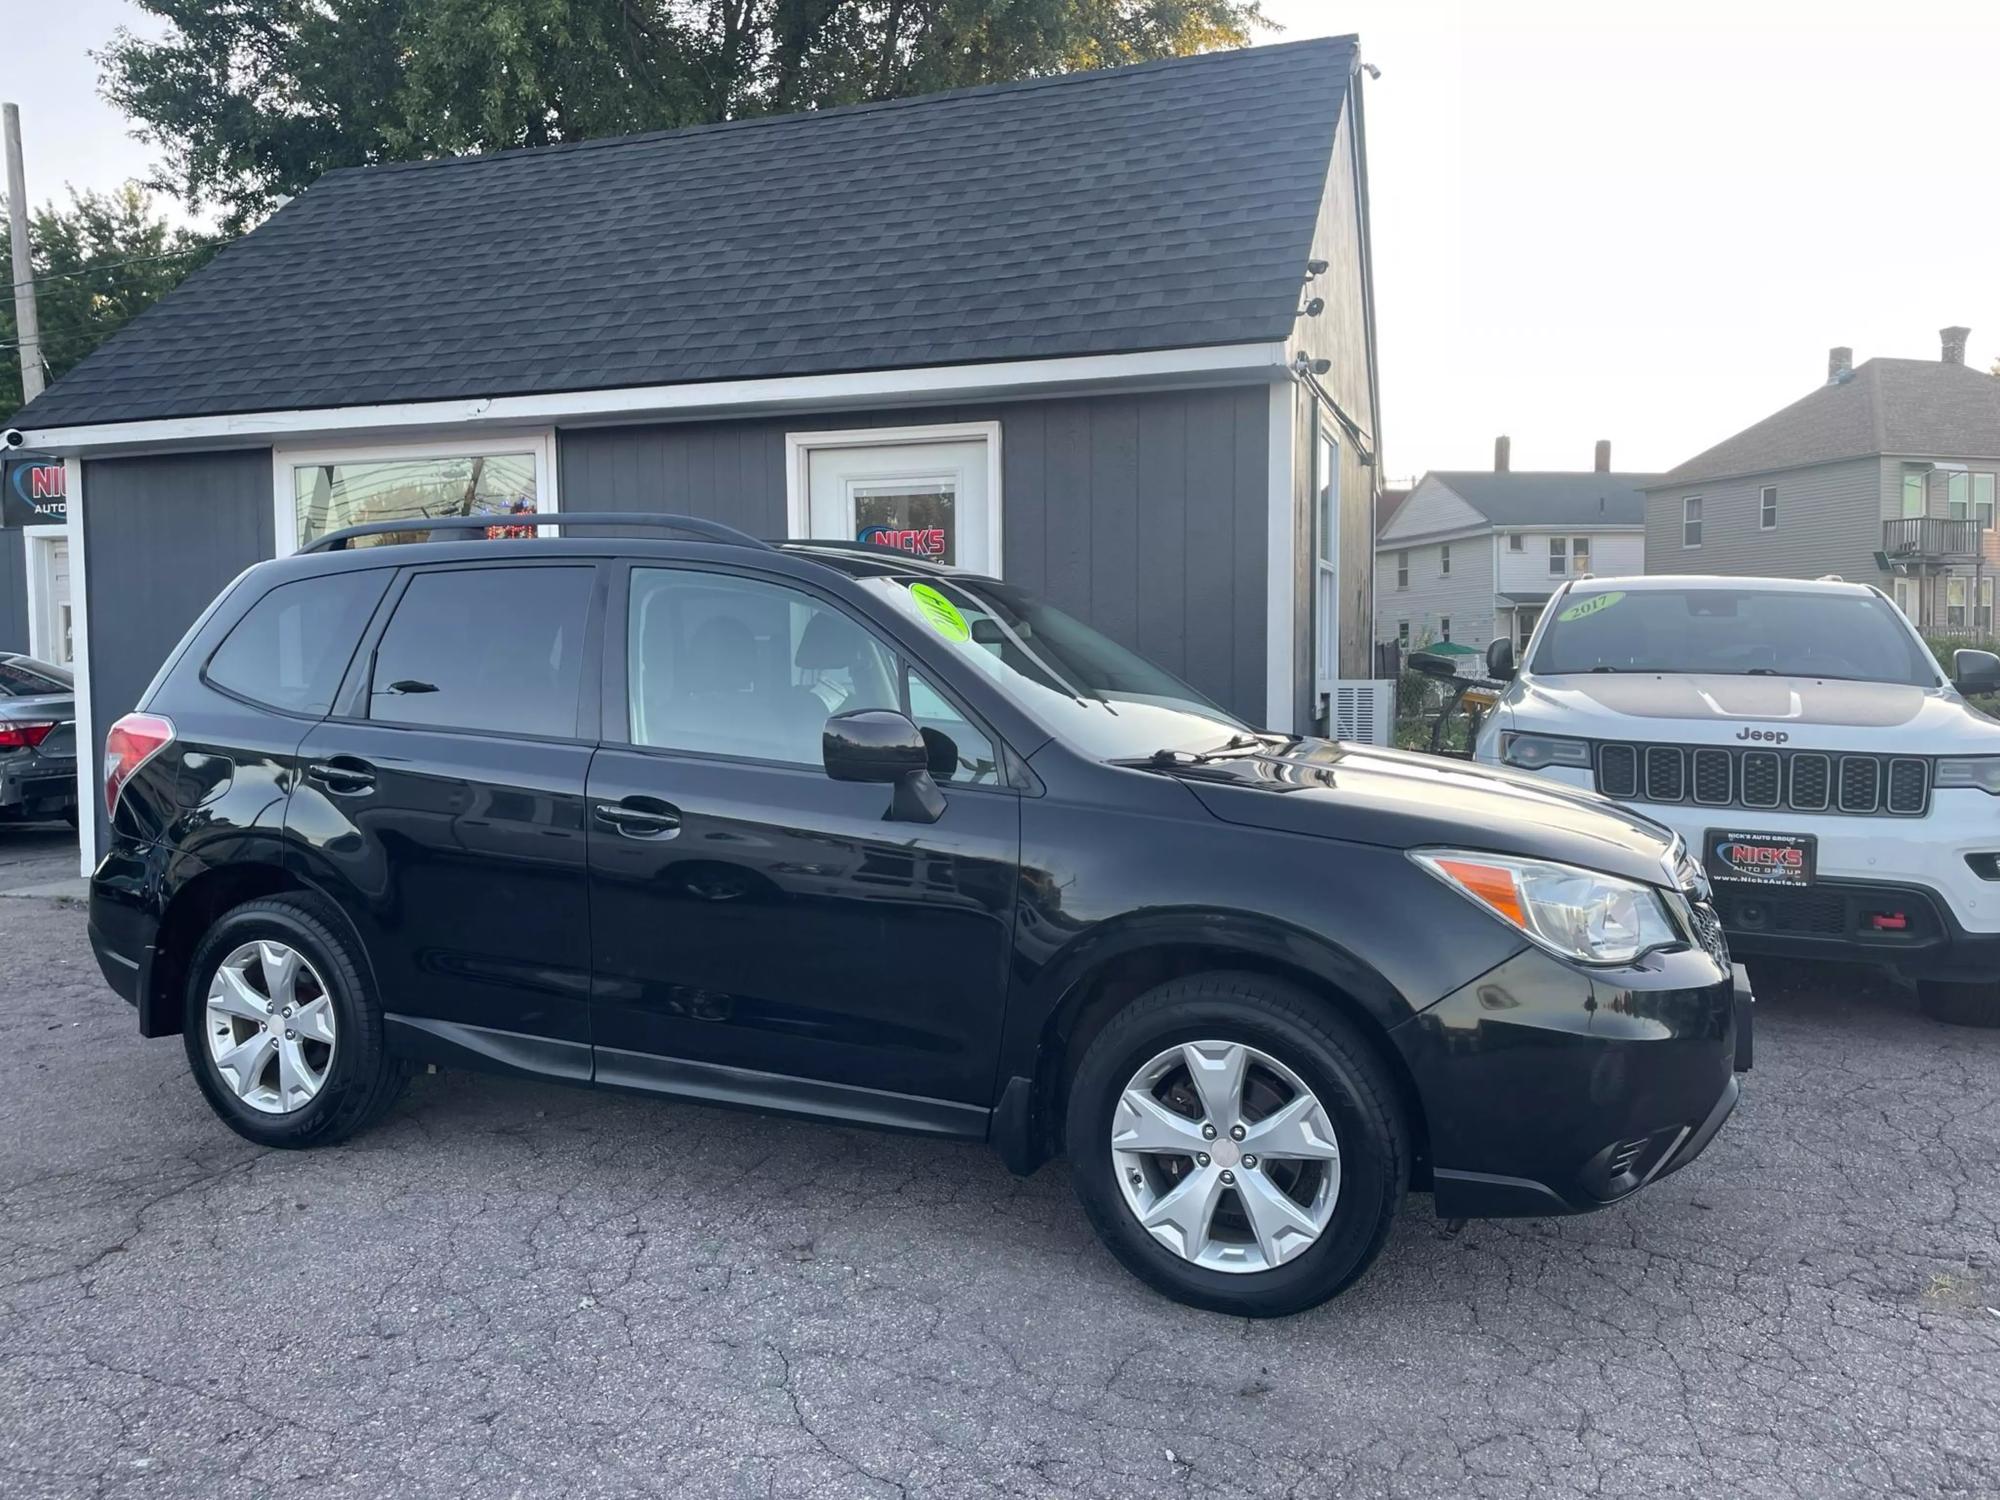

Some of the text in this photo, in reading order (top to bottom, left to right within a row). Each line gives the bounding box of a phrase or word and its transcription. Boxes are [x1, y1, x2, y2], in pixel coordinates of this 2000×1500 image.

[34, 503, 67, 514] AUTO
[1570, 595, 1607, 618] 2017
[1736, 727, 1789, 744] Jeep
[1732, 845, 1803, 867] NICK'S
[1713, 875, 1808, 887] www.NicksAuto.us
